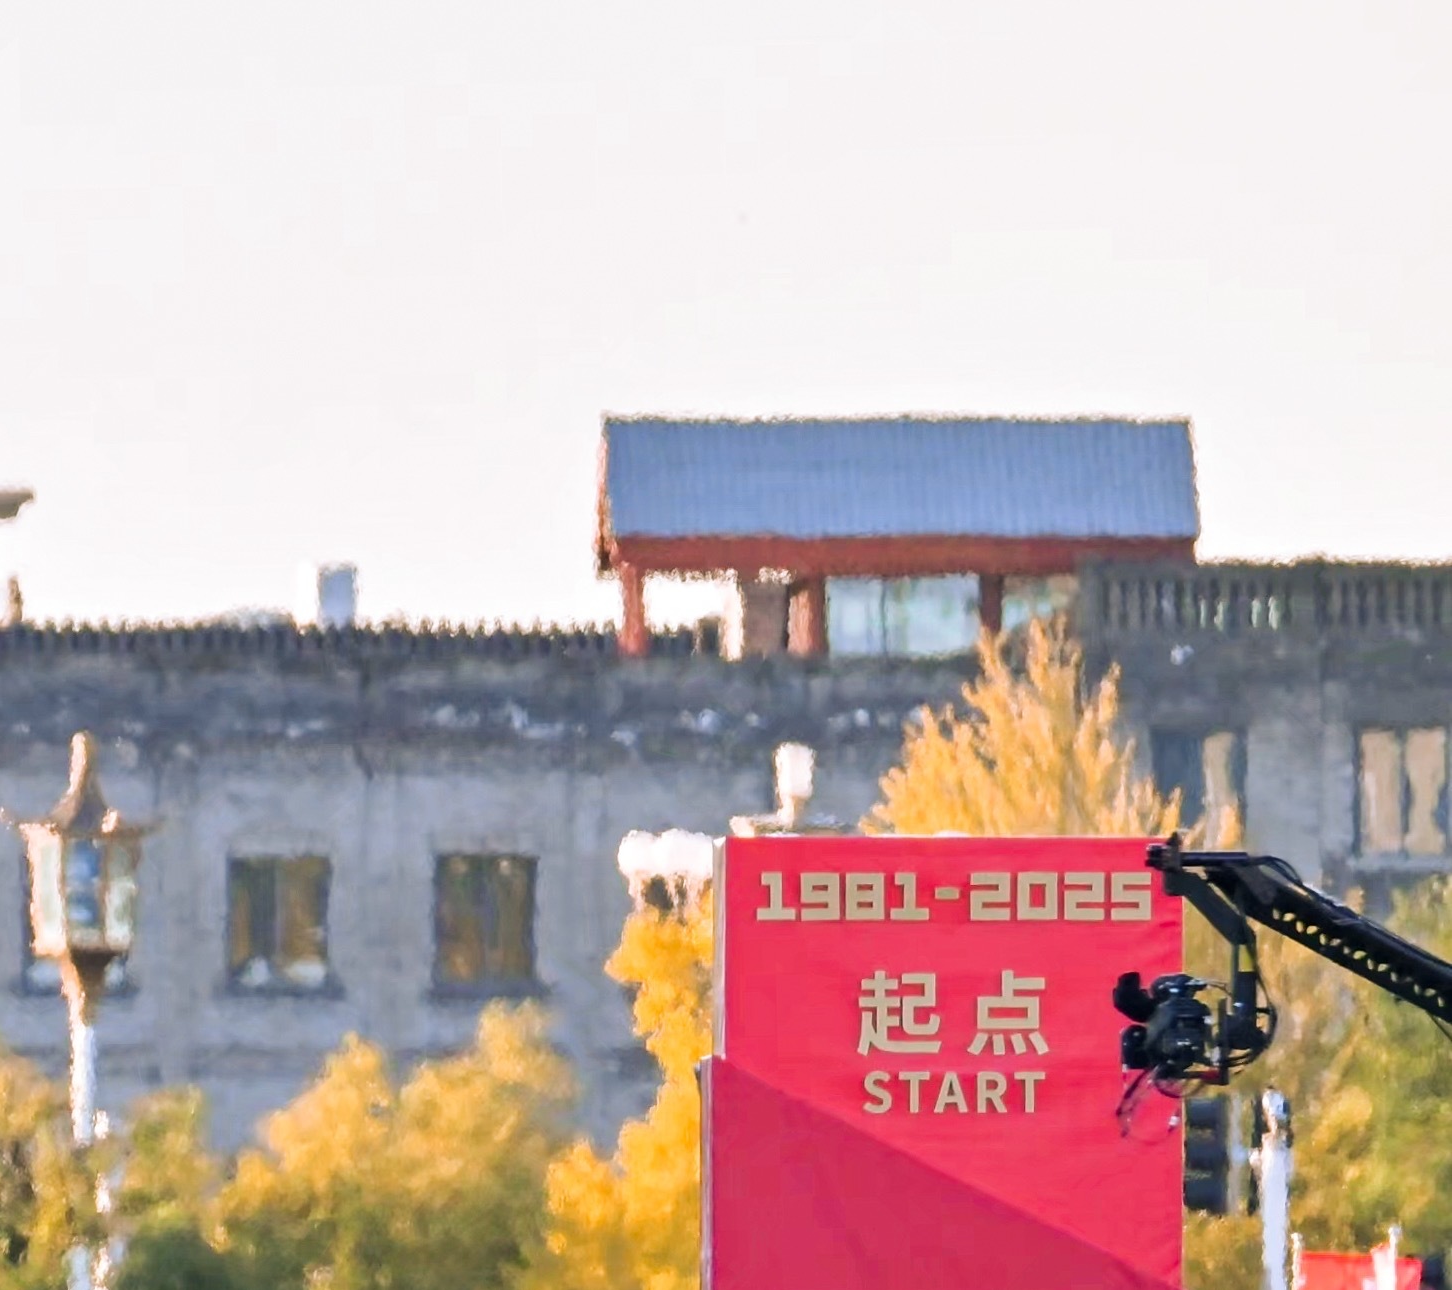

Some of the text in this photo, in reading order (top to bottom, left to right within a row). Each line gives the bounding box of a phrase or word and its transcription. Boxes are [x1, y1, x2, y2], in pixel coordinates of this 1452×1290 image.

[756, 870, 1152, 922] 1981-2025
[856, 968, 1051, 1057] 起点
[863, 1069, 1047, 1114] START
